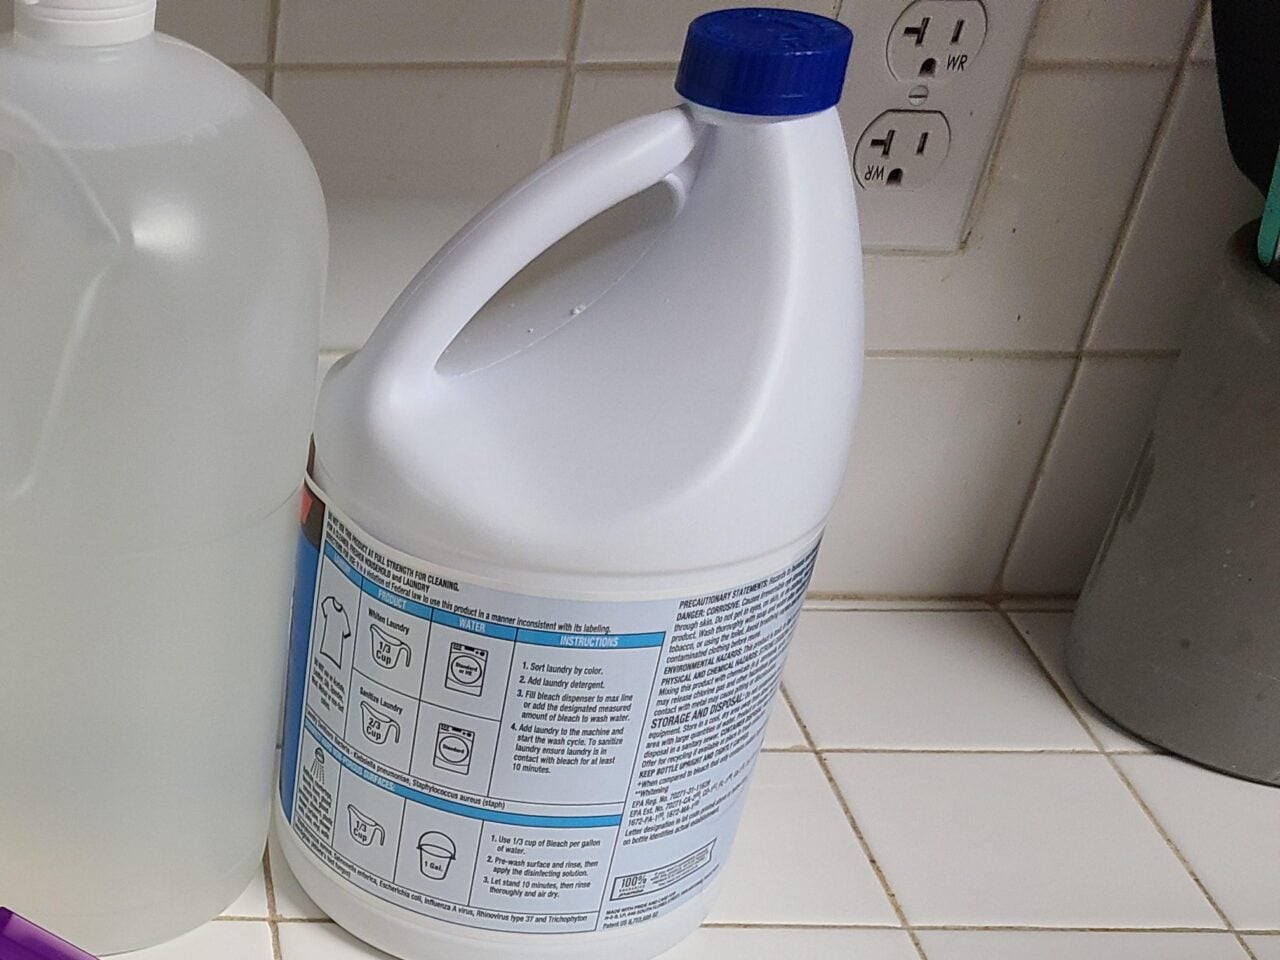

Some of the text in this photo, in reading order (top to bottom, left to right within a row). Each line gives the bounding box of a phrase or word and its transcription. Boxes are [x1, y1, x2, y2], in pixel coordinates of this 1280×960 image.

[946, 54, 968, 72] WR
[864, 165, 884, 181] WR
[364, 555, 391, 579] HOUSEHOLD
[391, 571, 402, 583] and
[402, 576, 430, 593] LAUNDRY
[373, 551, 460, 592] FULL STRENGTH FOR CLEANING.
[377, 589, 406, 609] PRODUCT
[678, 579, 768, 610] PRECAUTIONARY STATEMENTS:
[391, 580, 611, 635] Federal law use this product manner inconsistent with its labeling.
[676, 607, 705, 621] DANGER:
[368, 607, 410, 635] Whiten Laundry
[458, 618, 486, 633] WATER
[673, 619, 699, 633] through
[559, 635, 619, 648] INSTRUCTIONS
[670, 626, 714, 645] product. Wash
[378, 641, 391, 654] 1/3
[376, 650, 392, 665] Cup
[666, 651, 707, 664] contaminated
[530, 662, 604, 677] Sort laundry by color.
[660, 659, 734, 687] PHYSICAL AND CHEMICAL
[664, 657, 715, 676] ENVIRONMENTAL
[519, 675, 605, 691] 2. Add laundry detergent.
[516, 689, 633, 703] 3. Fill bleach dispenser to max line
[658, 685, 680, 697] Mixing
[360, 686, 403, 715] Sanitize Laundry
[523, 701, 632, 715] or add the designated measured
[650, 694, 744, 730] STORAGE AND DISPOSAL:
[654, 704, 691, 717] contact with
[368, 717, 381, 730] 2/3
[521, 711, 631, 723] amount of bleach to wash water.
[366, 726, 382, 741] Cup
[510, 722, 624, 737] 4. Add laundry to the machine and
[648, 729, 681, 740] equipment.
[517, 733, 624, 747] start the wash cycle. To sanitize
[661, 736, 674, 746] with
[515, 743, 592, 757] laundry ensure laundry
[644, 748, 669, 759] disposal
[513, 754, 616, 766] contact with bleach for at least
[512, 763, 551, 774] 10 minutes.
[639, 763, 678, 779] KEEP BOTTLE
[353, 751, 506, 810] Klebsiella pneumoniae, Staphylococcus aureus (staph)
[355, 820, 367, 833] 1/3
[353, 828, 368, 842] Cup
[498, 835, 601, 849] Use 1/3 cup of Bleach per gallon
[496, 845, 526, 856] of water.
[429, 863, 444, 873] Gal.
[486, 855, 599, 869] 2. Pre-wash surface and rinse, then
[493, 866, 589, 879] apply the disinfecting solution.
[483, 876, 591, 890] 3. Let stand 10 minutes, then rinse
[621, 875, 647, 888] 100%
[489, 886, 560, 899] thoroughly and air dry.
[379, 879, 588, 924] Escherichia Influenza virus, Rhinovirus type 37 and Trichophyton
